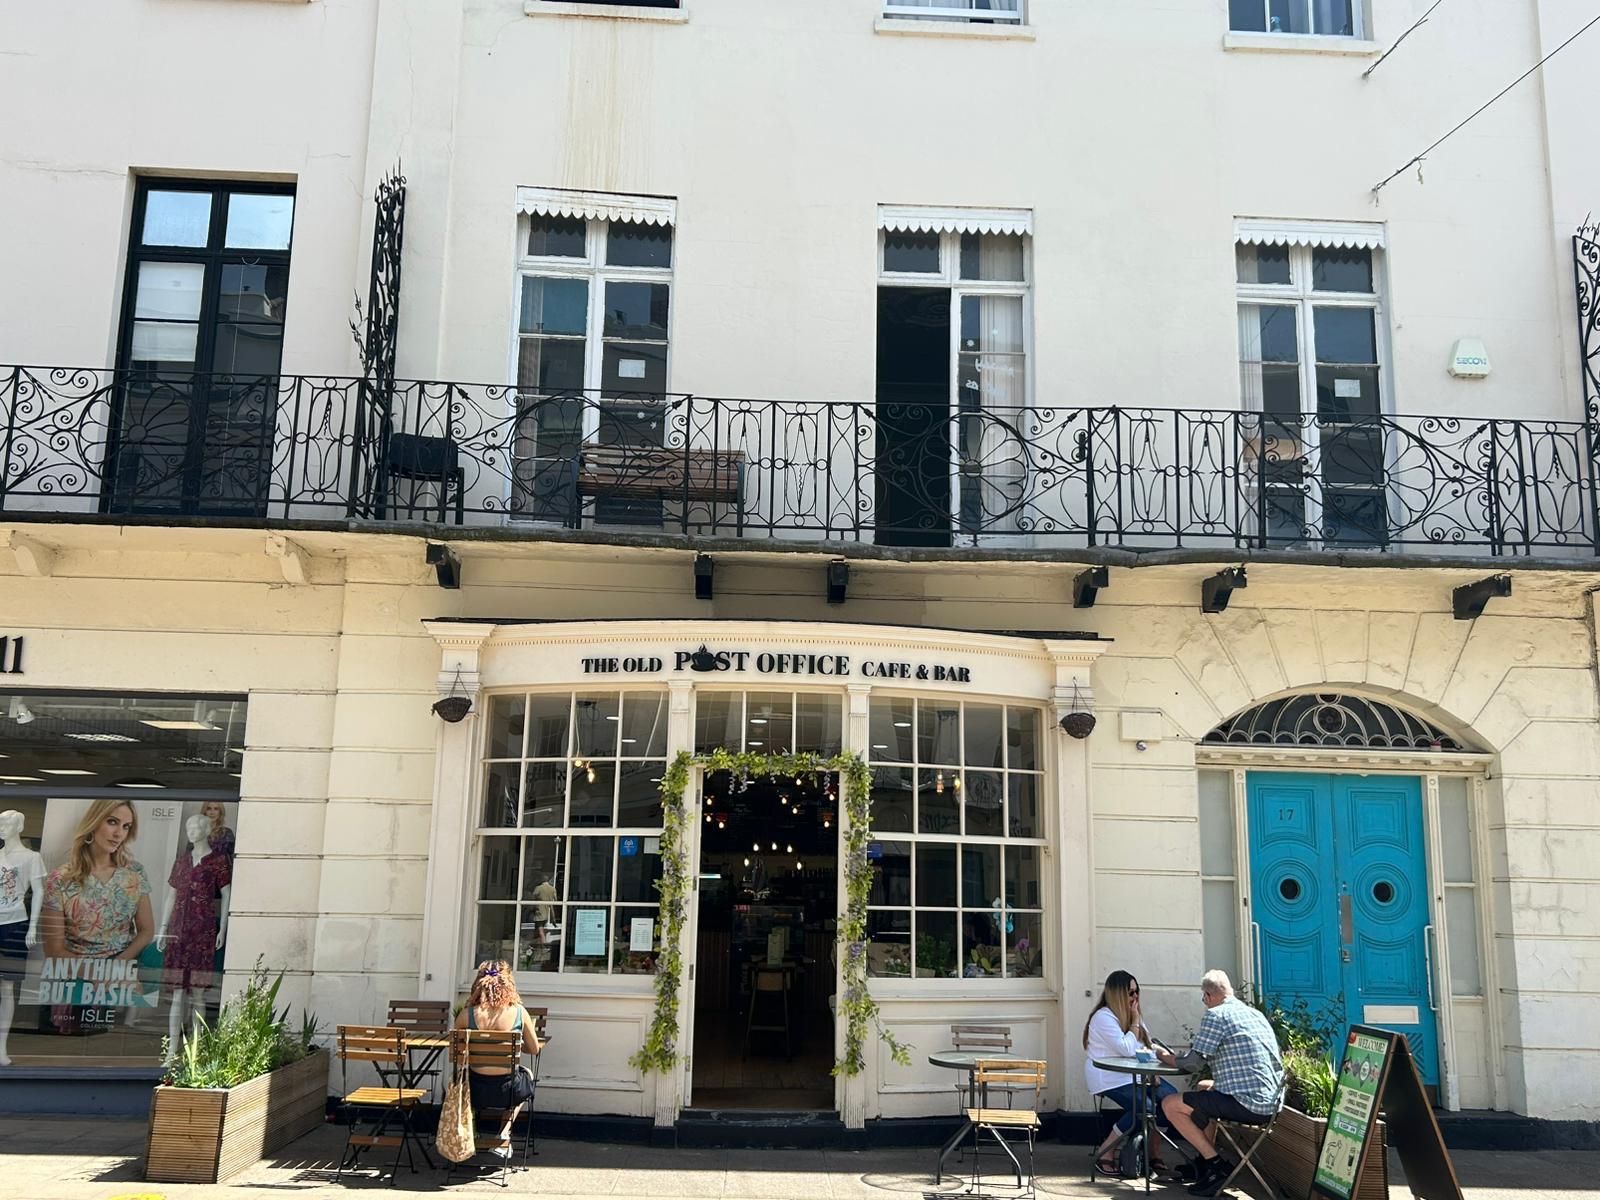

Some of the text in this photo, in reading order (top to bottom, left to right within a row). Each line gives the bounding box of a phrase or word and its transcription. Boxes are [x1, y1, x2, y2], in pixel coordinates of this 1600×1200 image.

[581, 657, 619, 673] THE
[622, 657, 663, 673] OLD
[756, 652, 850, 676] OFFICE
[861, 661, 911, 679] CAFE
[915, 664, 929, 680] &
[933, 665, 971, 682] BAR
[152, 807, 176, 817] ISLE
[1279, 808, 1294, 821] 17
[40, 957, 138, 981] ANYTHING
[38, 982, 137, 1006] BUT BASIC
[80, 1008, 117, 1023] ISLE
